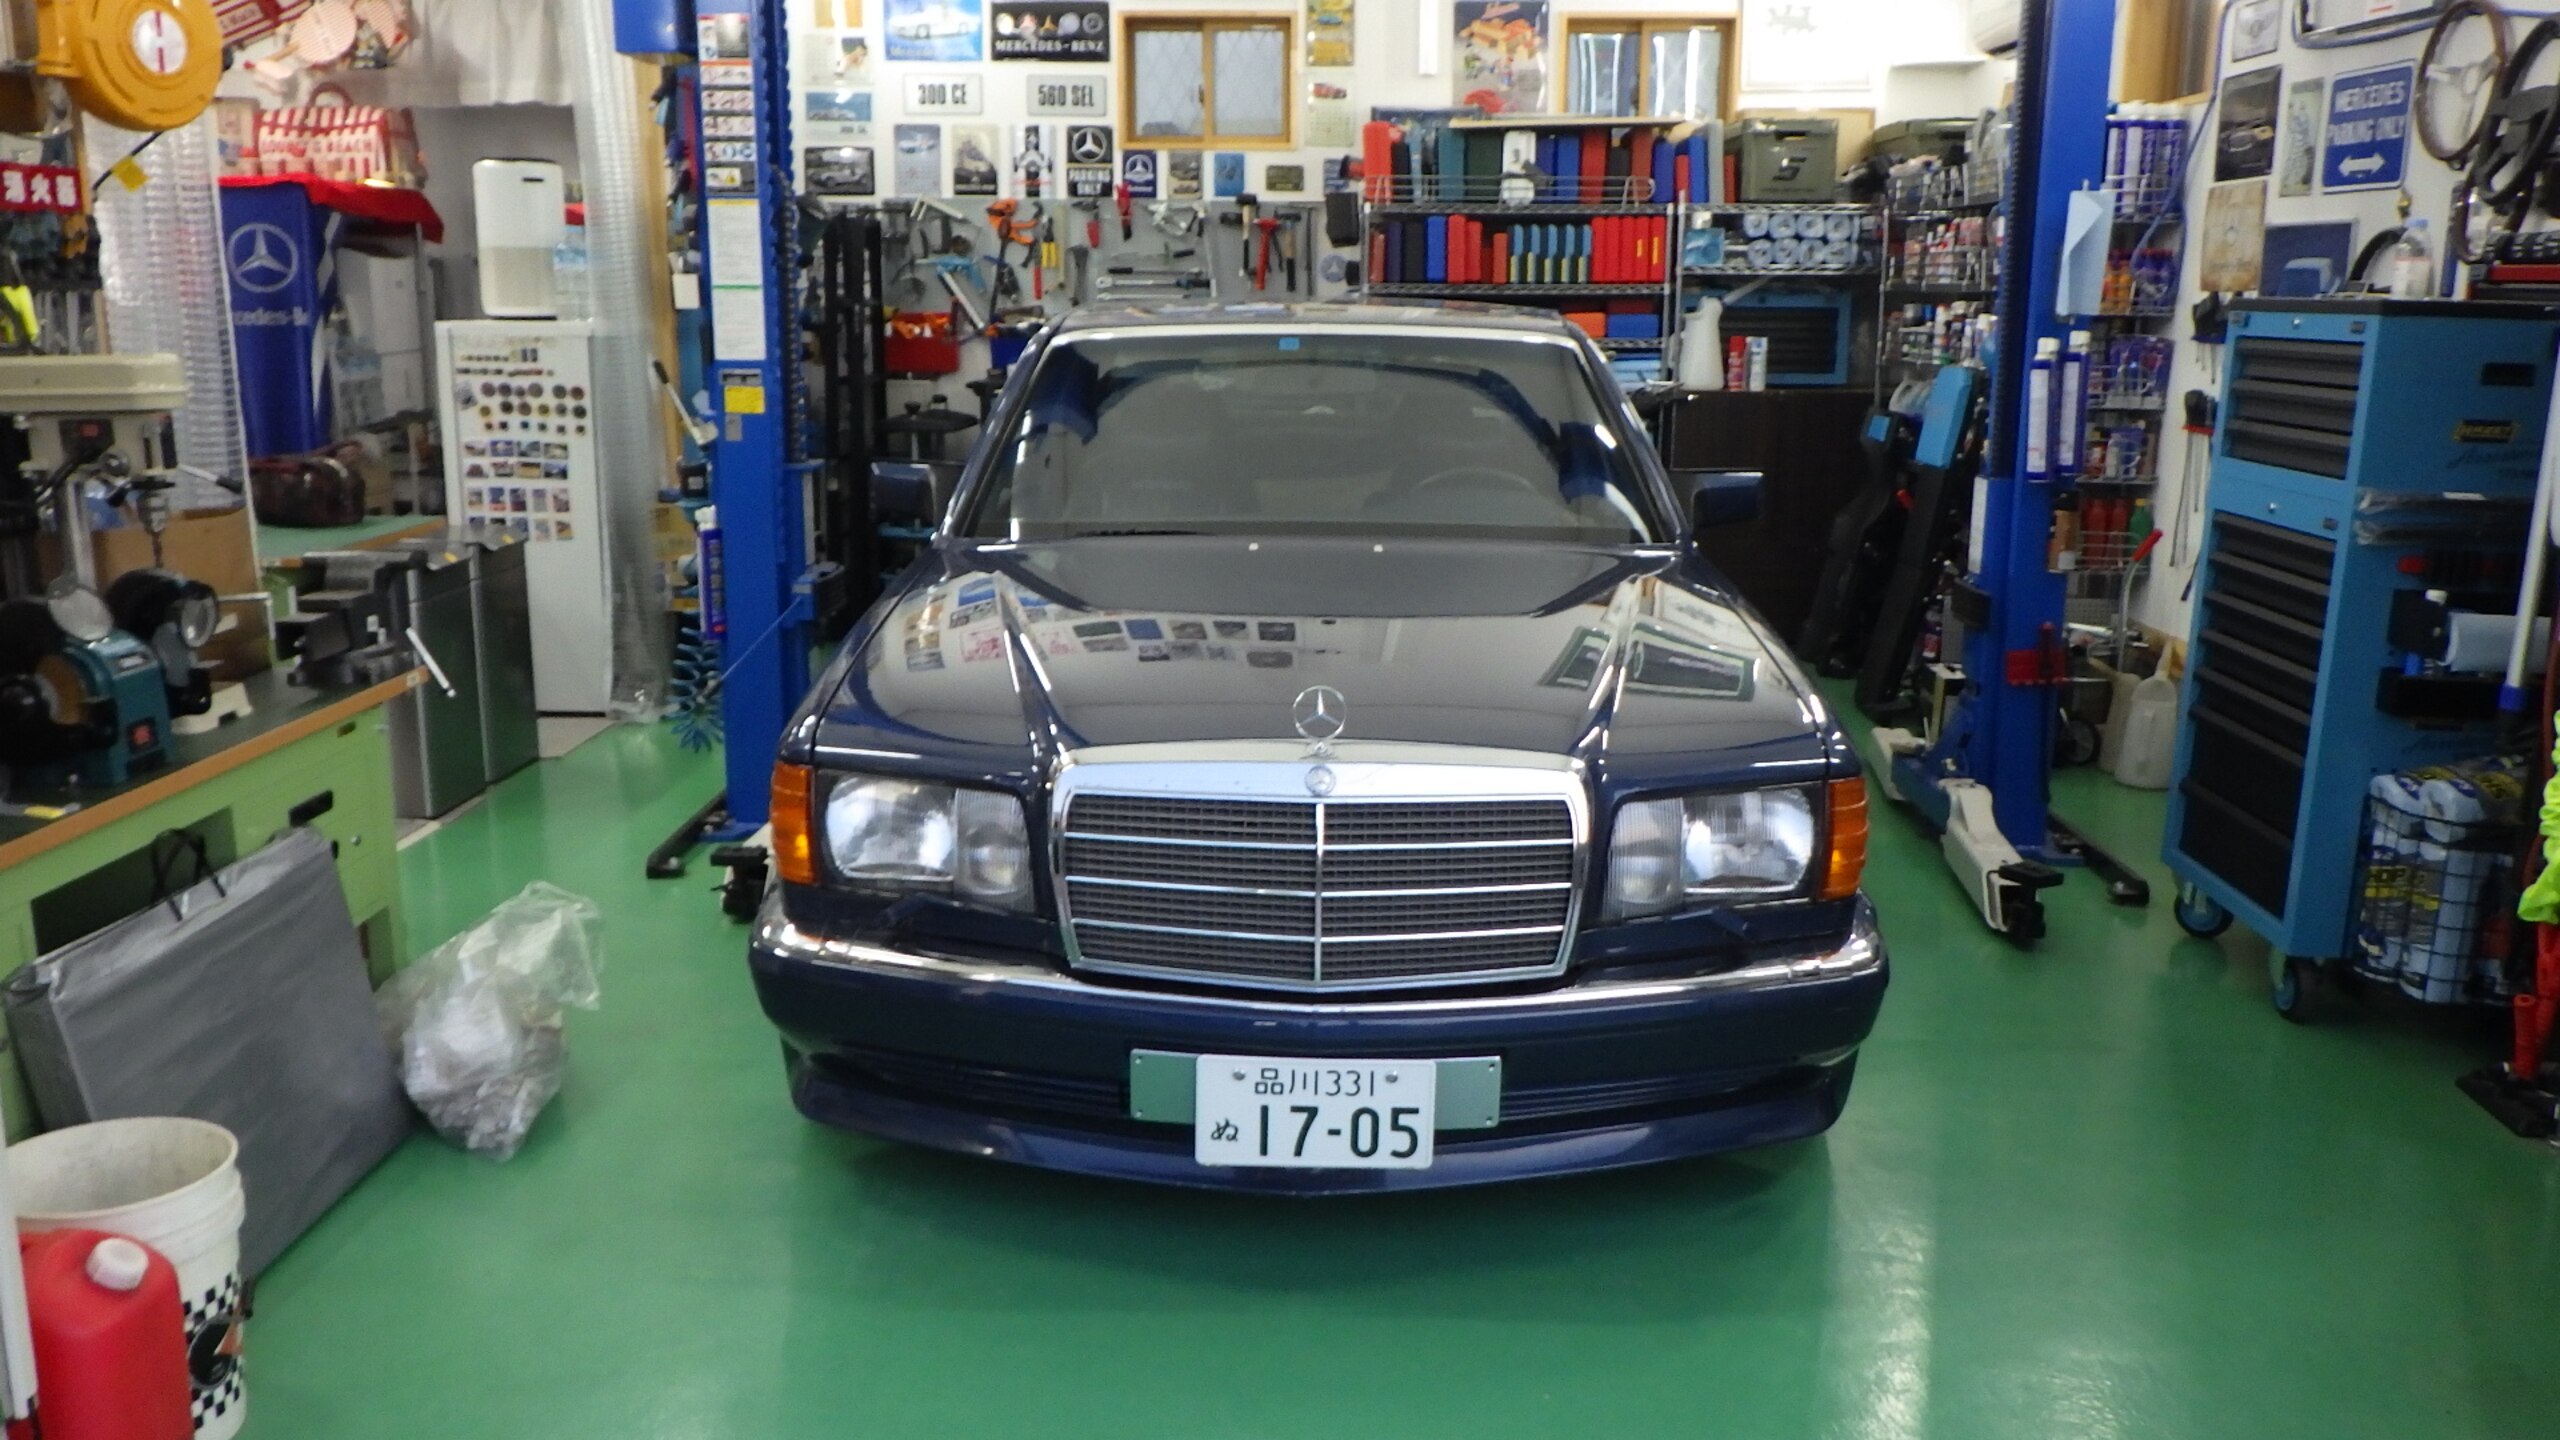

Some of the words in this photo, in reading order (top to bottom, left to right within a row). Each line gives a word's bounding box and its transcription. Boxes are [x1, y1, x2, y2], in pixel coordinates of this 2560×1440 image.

[995, 39, 1104, 53] MERCEDES-BENZ
[918, 84, 947, 105] 300
[951, 84, 967, 105] CE
[1038, 84, 1067, 107] 560
[1071, 84, 1094, 107] SEL
[2335, 81, 2405, 113] MERCEDES
[2327, 119, 2374, 146] PARKING
[2376, 115, 2405, 140] ONLY
[1211, 1117, 1238, 1142] ぬ
[1259, 1104, 1419, 1159] 17-05
